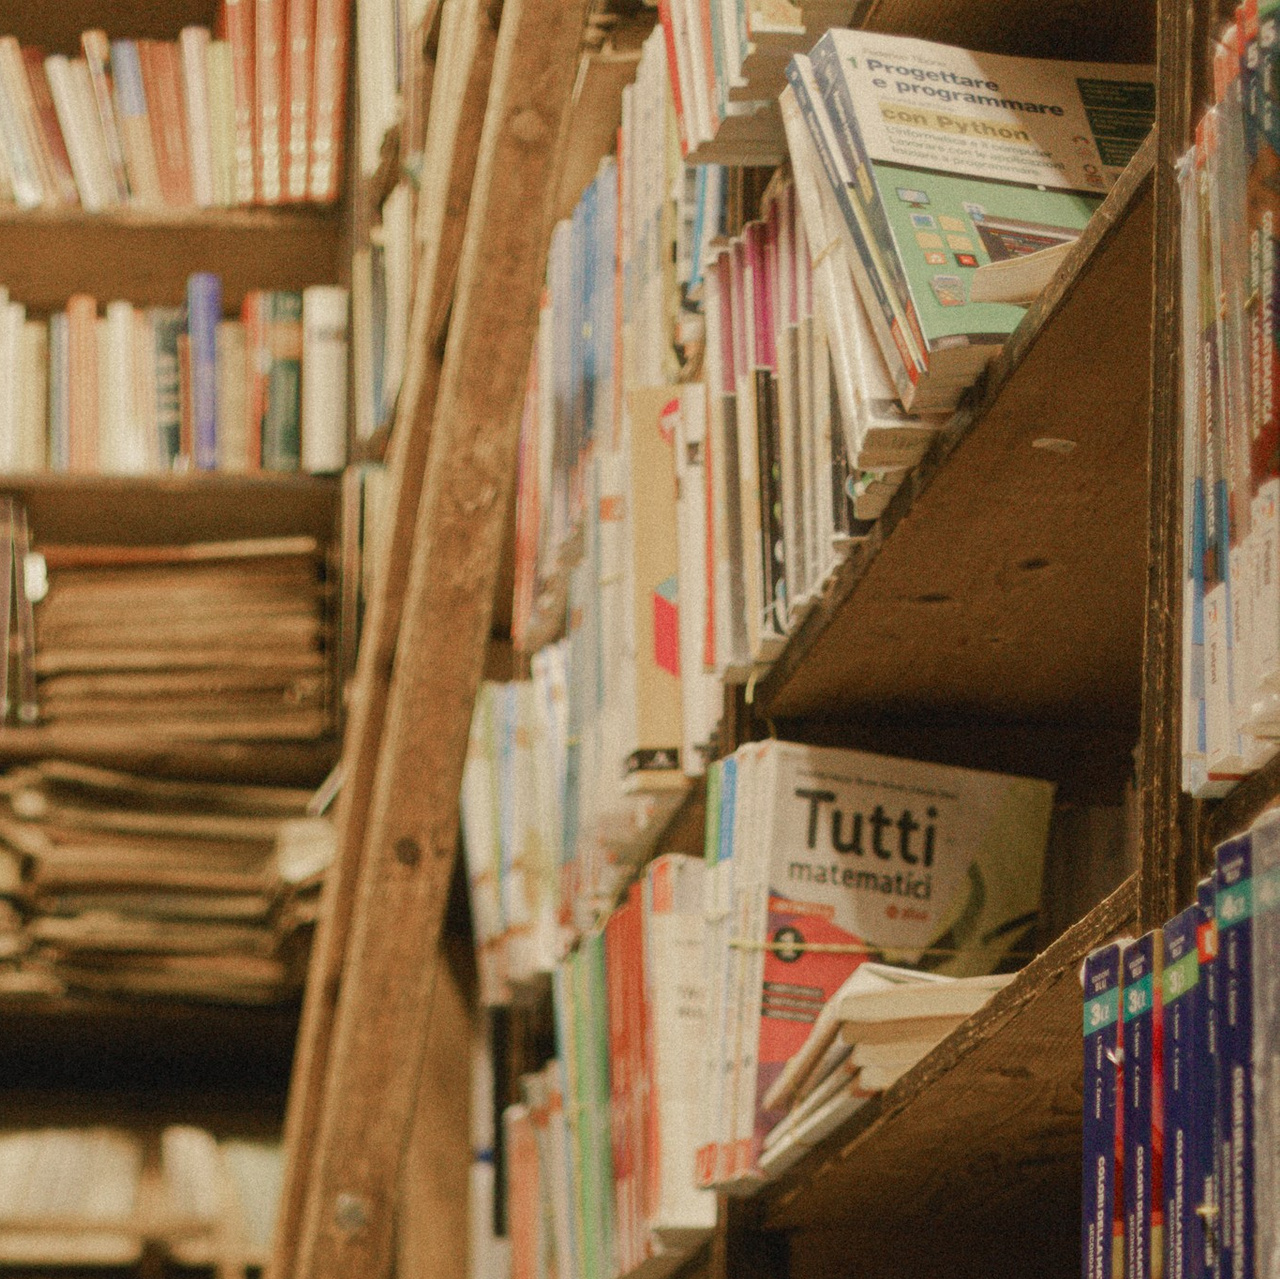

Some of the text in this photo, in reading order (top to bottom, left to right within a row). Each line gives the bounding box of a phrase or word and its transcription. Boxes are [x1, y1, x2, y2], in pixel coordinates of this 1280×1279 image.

[866, 58, 1000, 93] Progettare
[873, 76, 888, 89] e
[896, 79, 1065, 117] programmare
[881, 107, 1031, 143] con Python
[795, 787, 938, 868] Tutti
[789, 861, 933, 900] matematici
[1136, 1147, 1145, 1199] COLORI
[1176, 1128, 1184, 1184] COLORI
[1097, 1156, 1106, 1208] COLORI
[1136, 1201, 1145, 1245] DELLA
[1175, 1186, 1184, 1232] DELLA
[1095, 1211, 1105, 1255] DELLA
